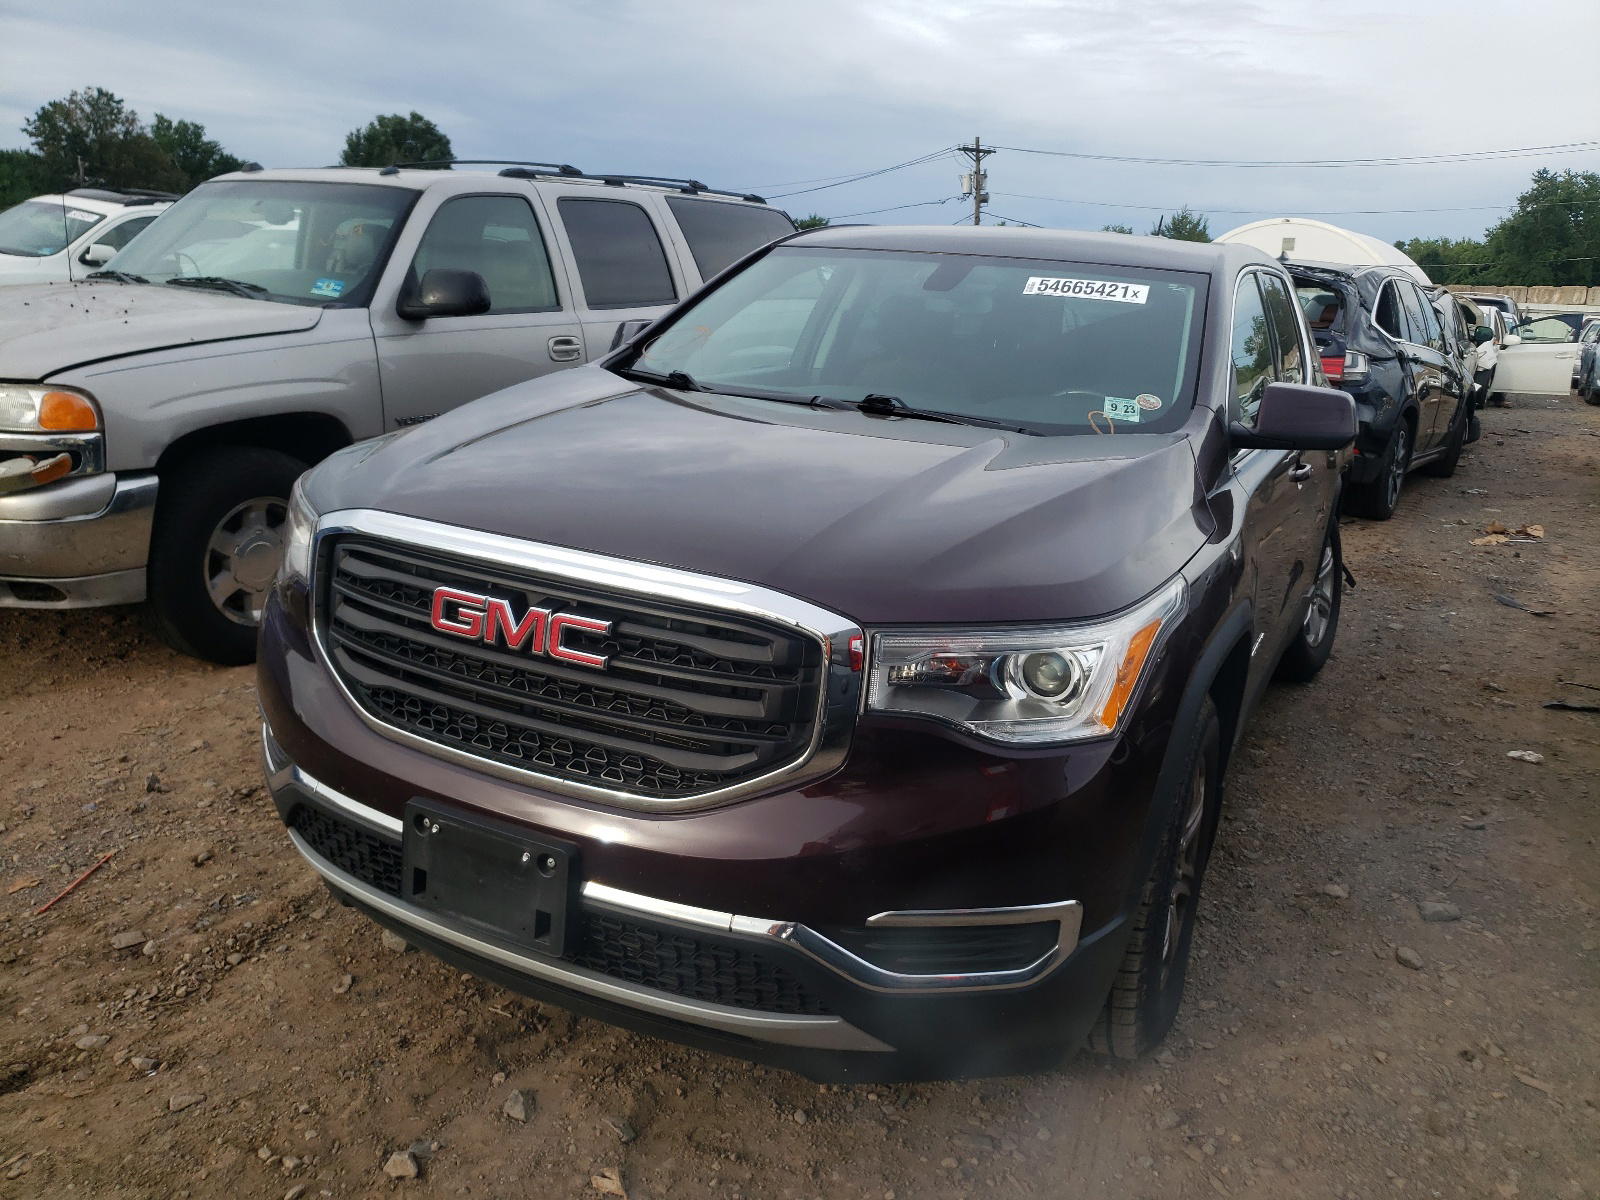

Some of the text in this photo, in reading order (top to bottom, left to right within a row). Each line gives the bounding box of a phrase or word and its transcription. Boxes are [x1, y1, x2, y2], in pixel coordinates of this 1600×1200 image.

[1111, 403, 1136, 414] 9 23
[431, 586, 613, 671] GMC
